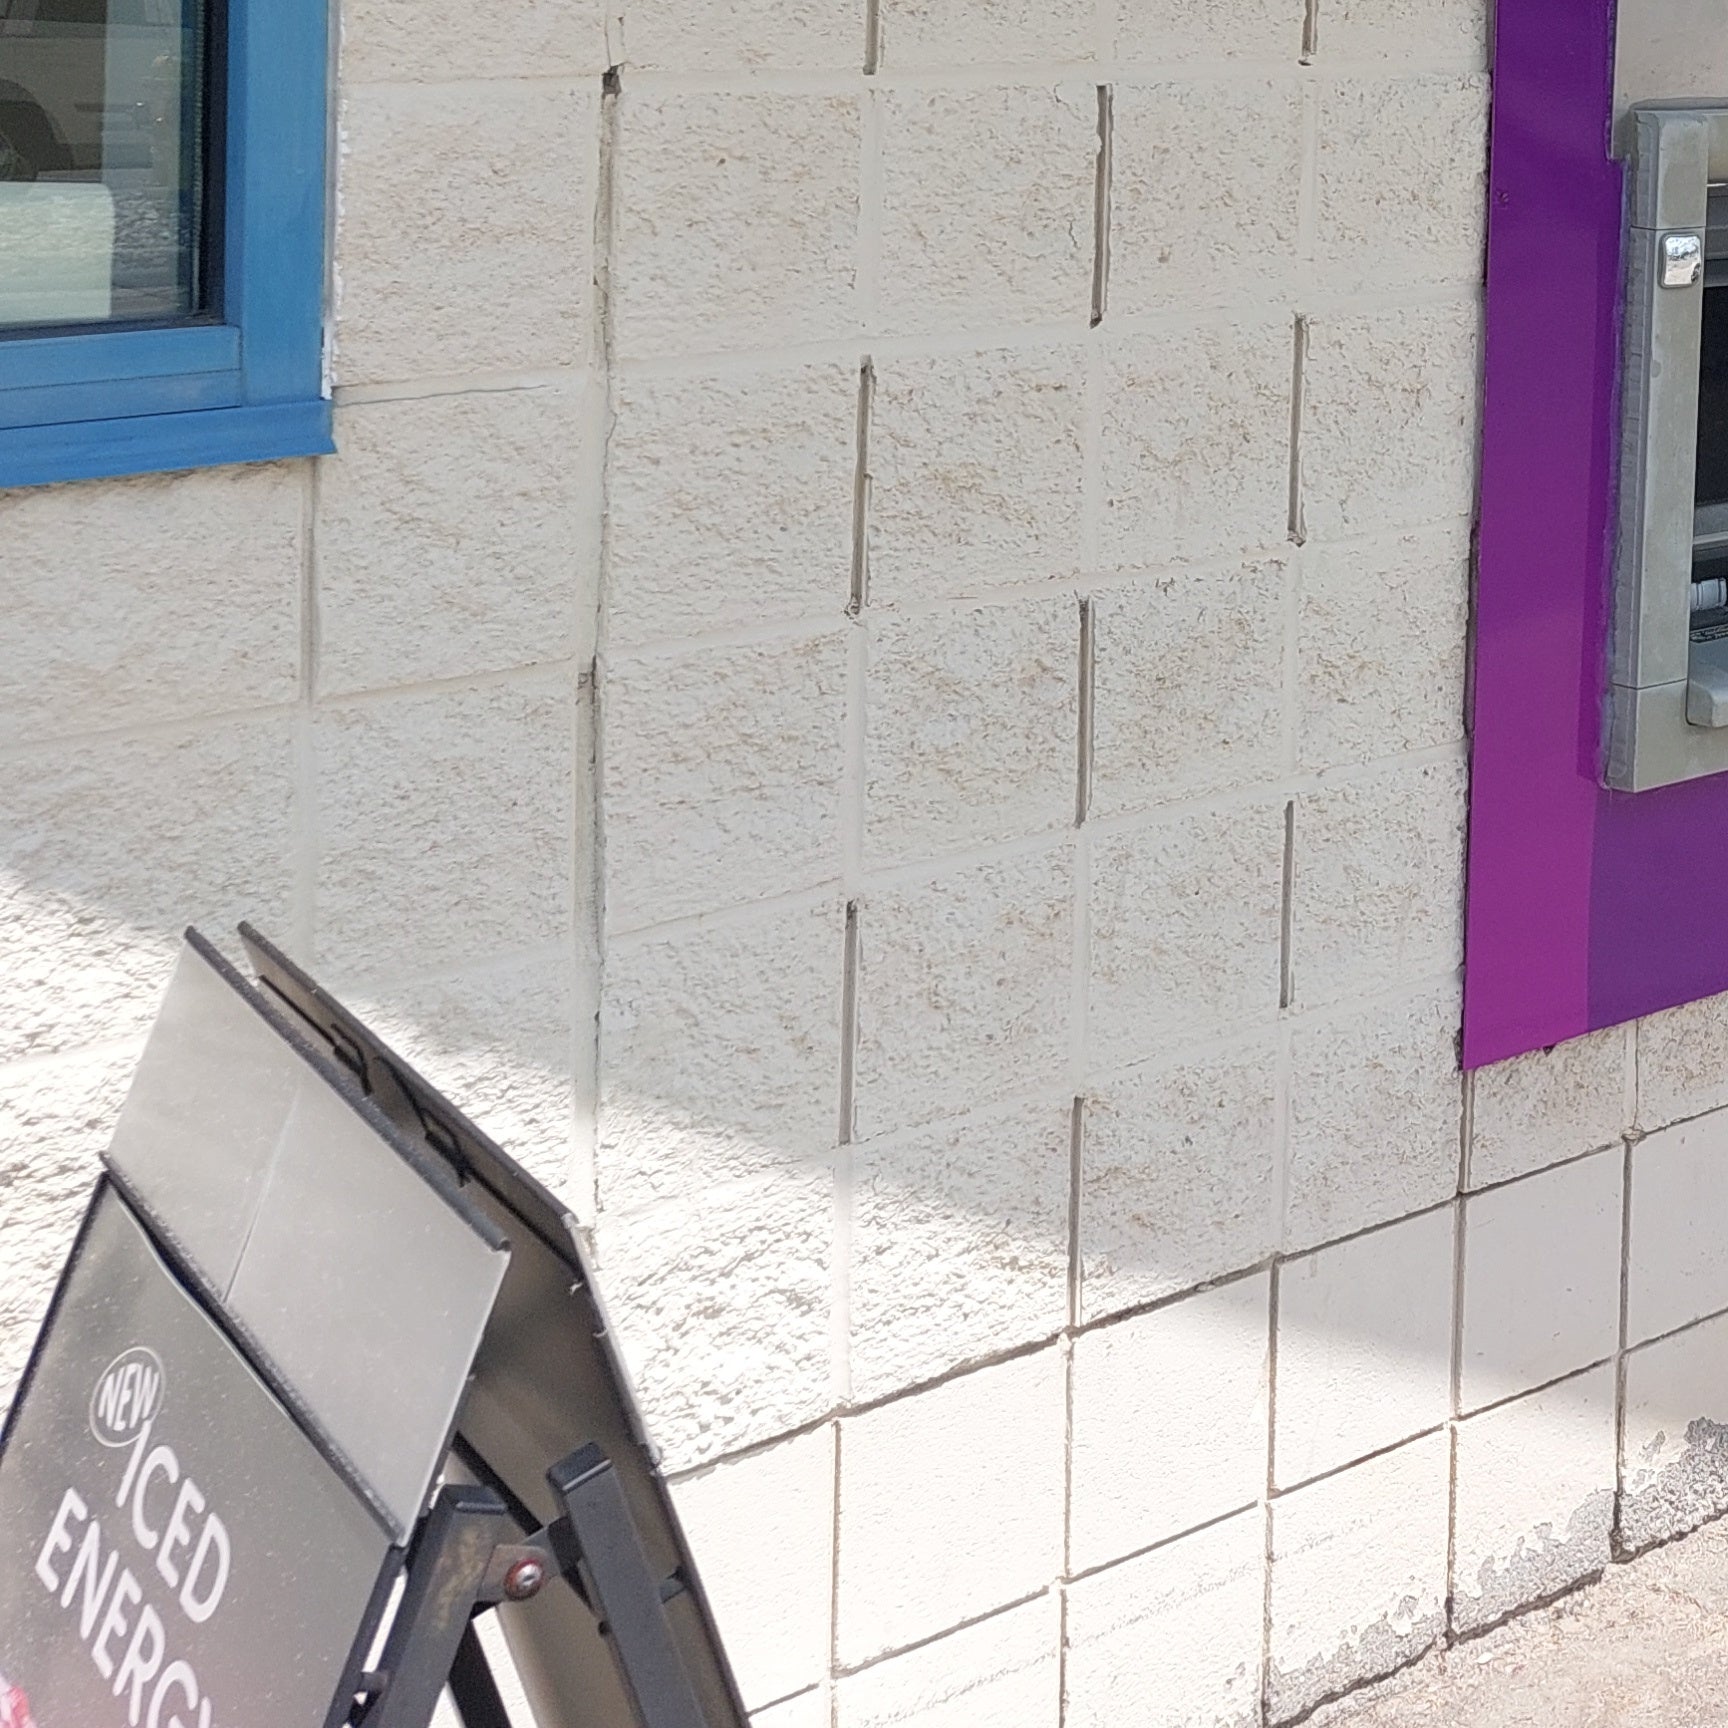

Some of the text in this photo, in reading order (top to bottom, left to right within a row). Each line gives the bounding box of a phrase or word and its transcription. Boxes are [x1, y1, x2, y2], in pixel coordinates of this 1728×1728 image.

[97, 1362, 160, 1432] NEW
[34, 1486, 212, 1728] ENERG
[115, 1419, 232, 1624] ICED
